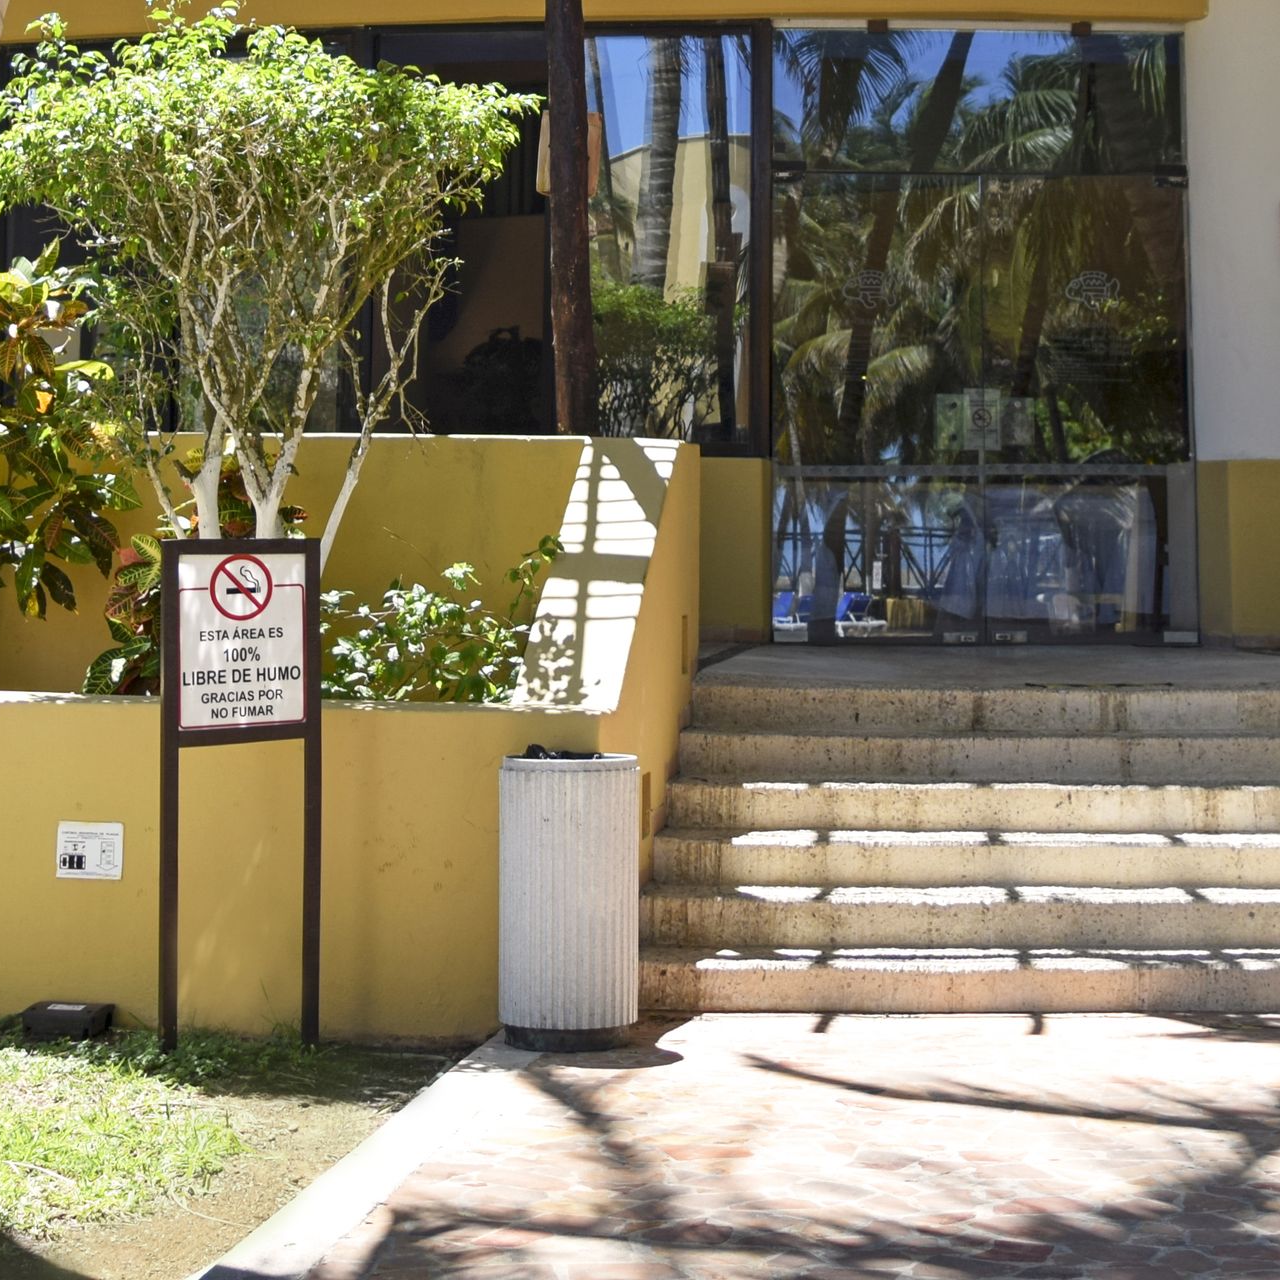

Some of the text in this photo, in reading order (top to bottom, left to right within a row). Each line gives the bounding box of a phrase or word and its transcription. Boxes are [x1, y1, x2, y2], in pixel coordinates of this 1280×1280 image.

[199, 626, 284, 642] ESTA ÁREA ES
[223, 646, 261, 663] 100%
[182, 665, 302, 687] LIBRE DE HUMO
[201, 688, 284, 705] GRACIAS POR
[210, 704, 274, 720] NO FUMAR
